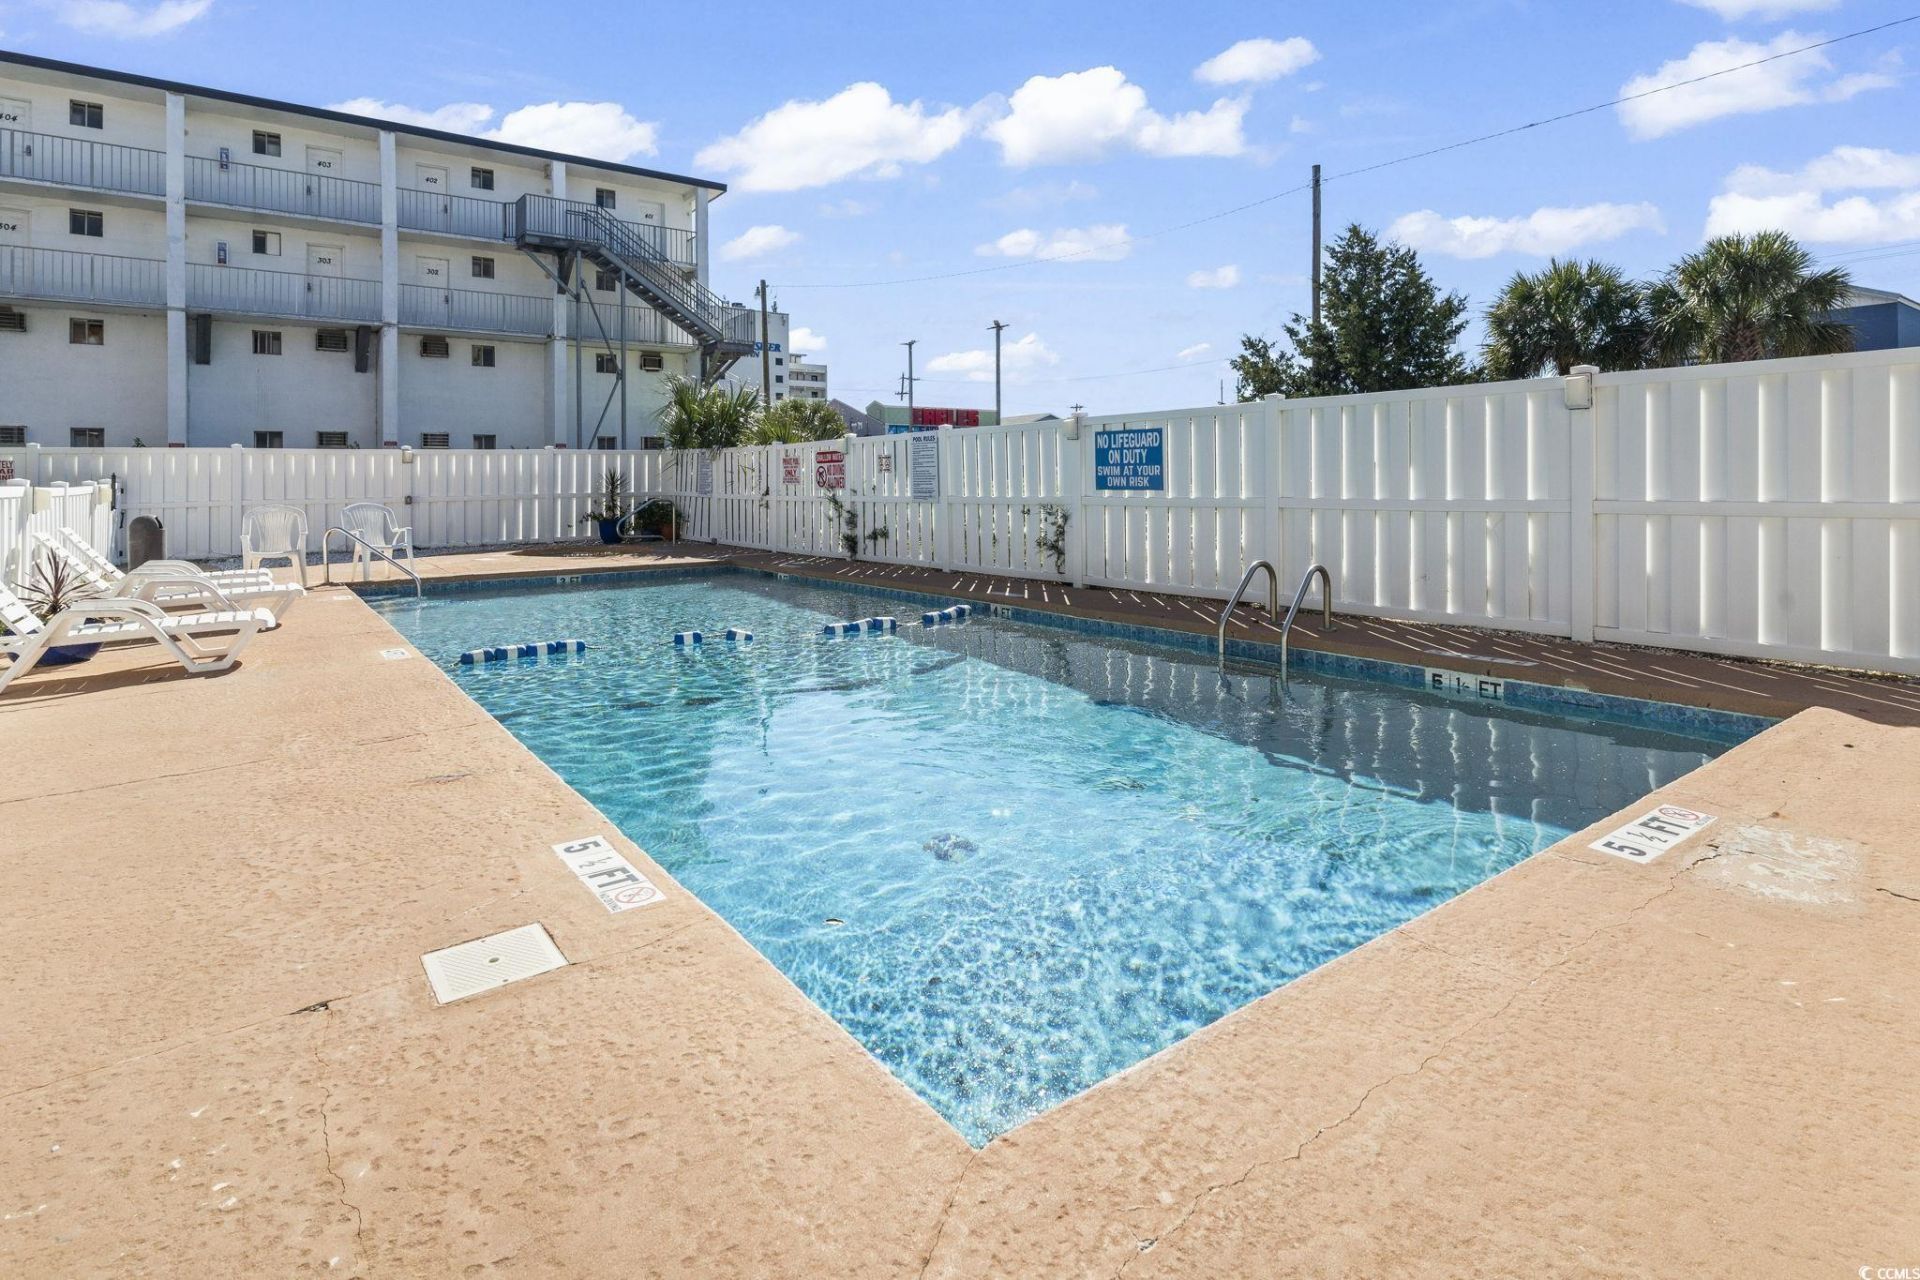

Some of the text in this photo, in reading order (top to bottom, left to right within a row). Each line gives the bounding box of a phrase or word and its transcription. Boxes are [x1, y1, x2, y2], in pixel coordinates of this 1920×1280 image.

[317, 160, 332, 168] 403
[426, 268, 439, 276] 302
[1097, 431, 1160, 449] NO LIFEGUARD
[1108, 448, 1148, 464] ON DUTY
[1097, 465, 1160, 476] SWIM AT YOUR
[1107, 476, 1149, 487] OWN RISK
[1602, 841, 1647, 857] 5
[1638, 816, 1691, 836] FT
[563, 840, 601, 853] 5
[587, 866, 640, 888] FT
